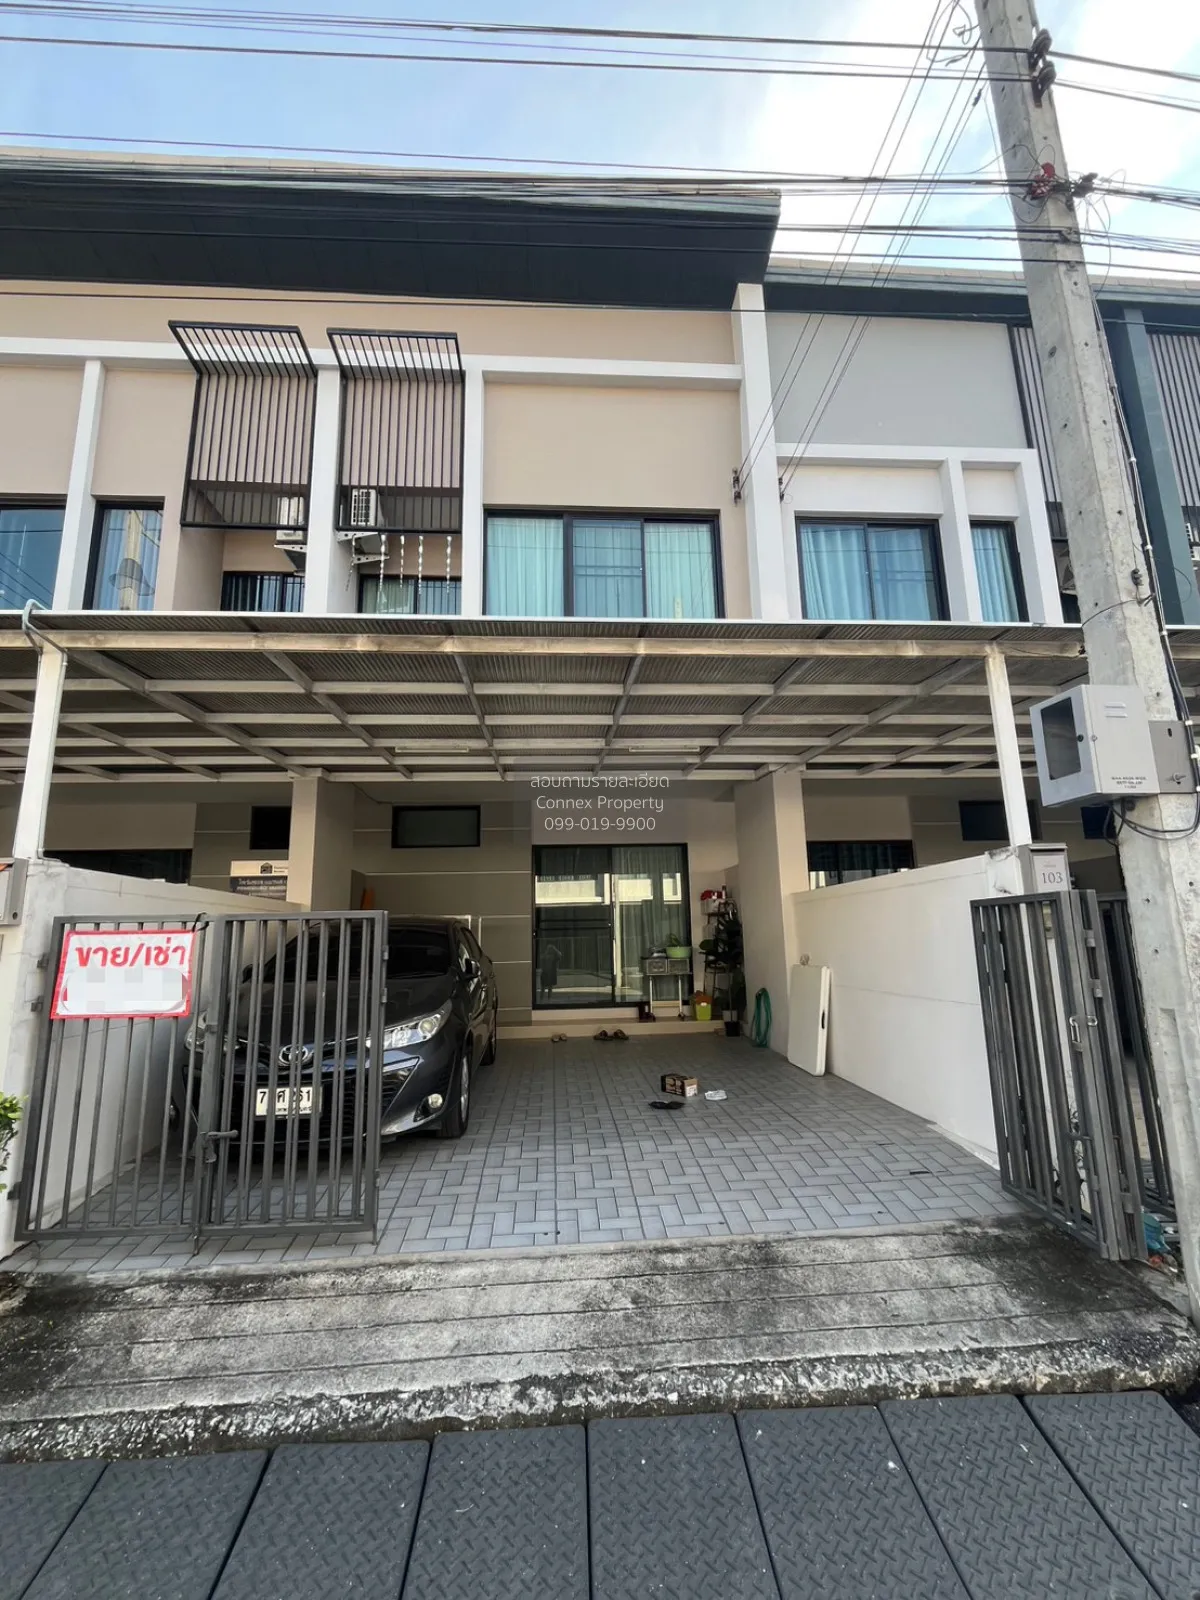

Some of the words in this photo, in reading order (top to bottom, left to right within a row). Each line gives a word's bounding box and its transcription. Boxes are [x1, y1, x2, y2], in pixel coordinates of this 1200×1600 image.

[1041, 872, 1063, 884] 103
[75, 937, 187, 968] ขาย/เช่า
